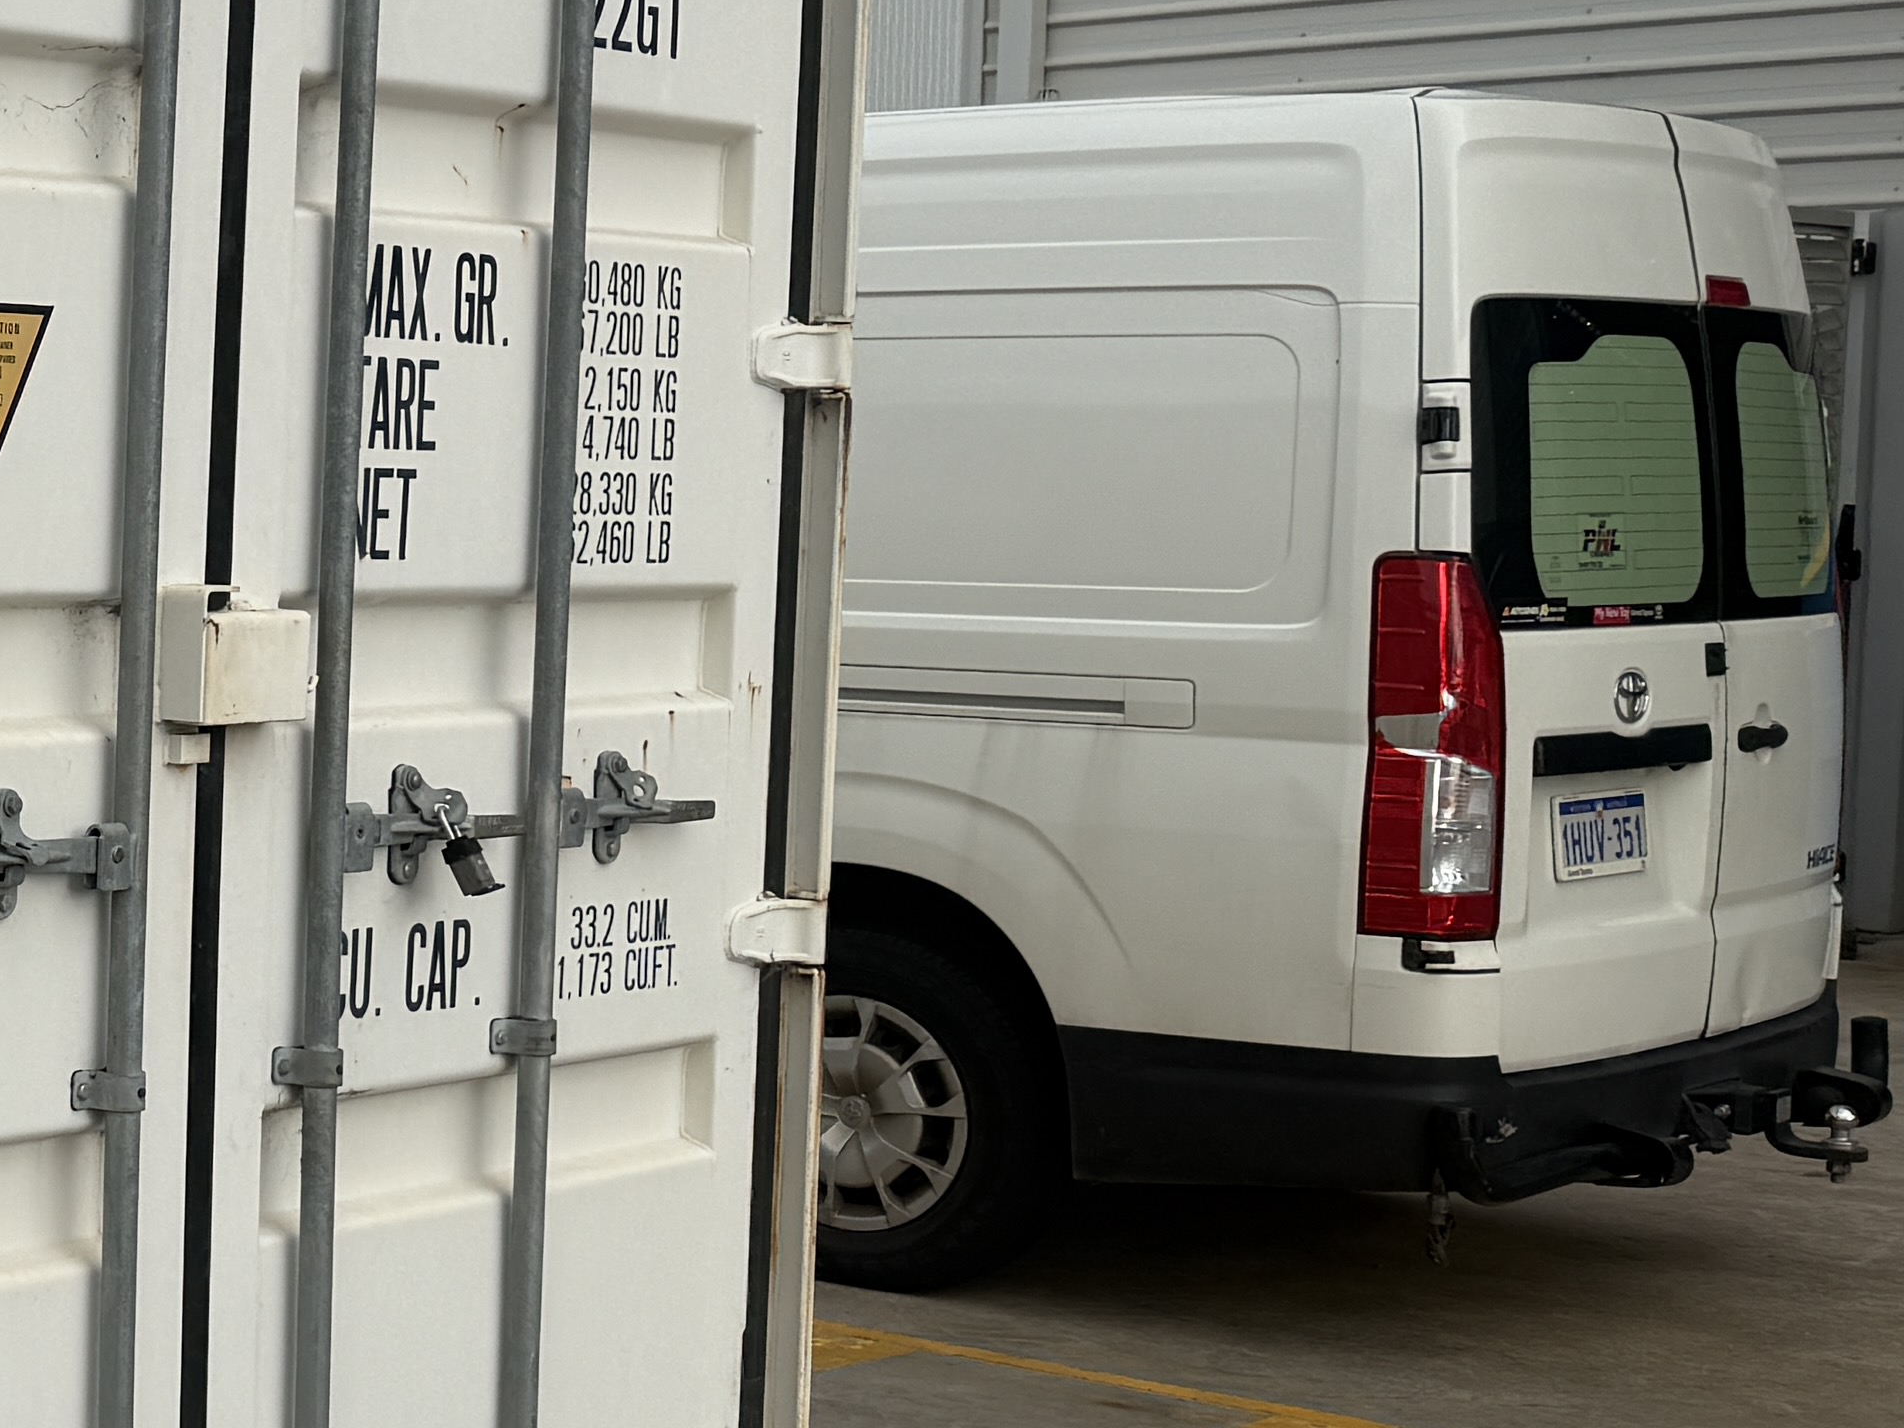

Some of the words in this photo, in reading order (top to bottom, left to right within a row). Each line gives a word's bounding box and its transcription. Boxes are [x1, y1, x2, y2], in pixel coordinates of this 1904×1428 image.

[454, 252, 509, 348] GR.
[584, 260, 645, 308] 0,480
[657, 265, 682, 310] KG
[581, 309, 644, 357] 7,200
[655, 314, 680, 359] LB
[584, 366, 642, 412] 2,150
[652, 369, 677, 413] KG
[582, 415, 640, 462] 4,740
[650, 418, 675, 461] LB
[648, 472, 673, 516] KG
[646, 521, 671, 564] LB
[570, 903, 615, 950] 33.2
[626, 898, 671, 944] CU.M.
[405, 918, 480, 1013] CAP.
[558, 951, 613, 1001] 1,173
[624, 943, 678, 992] CU.FT.
